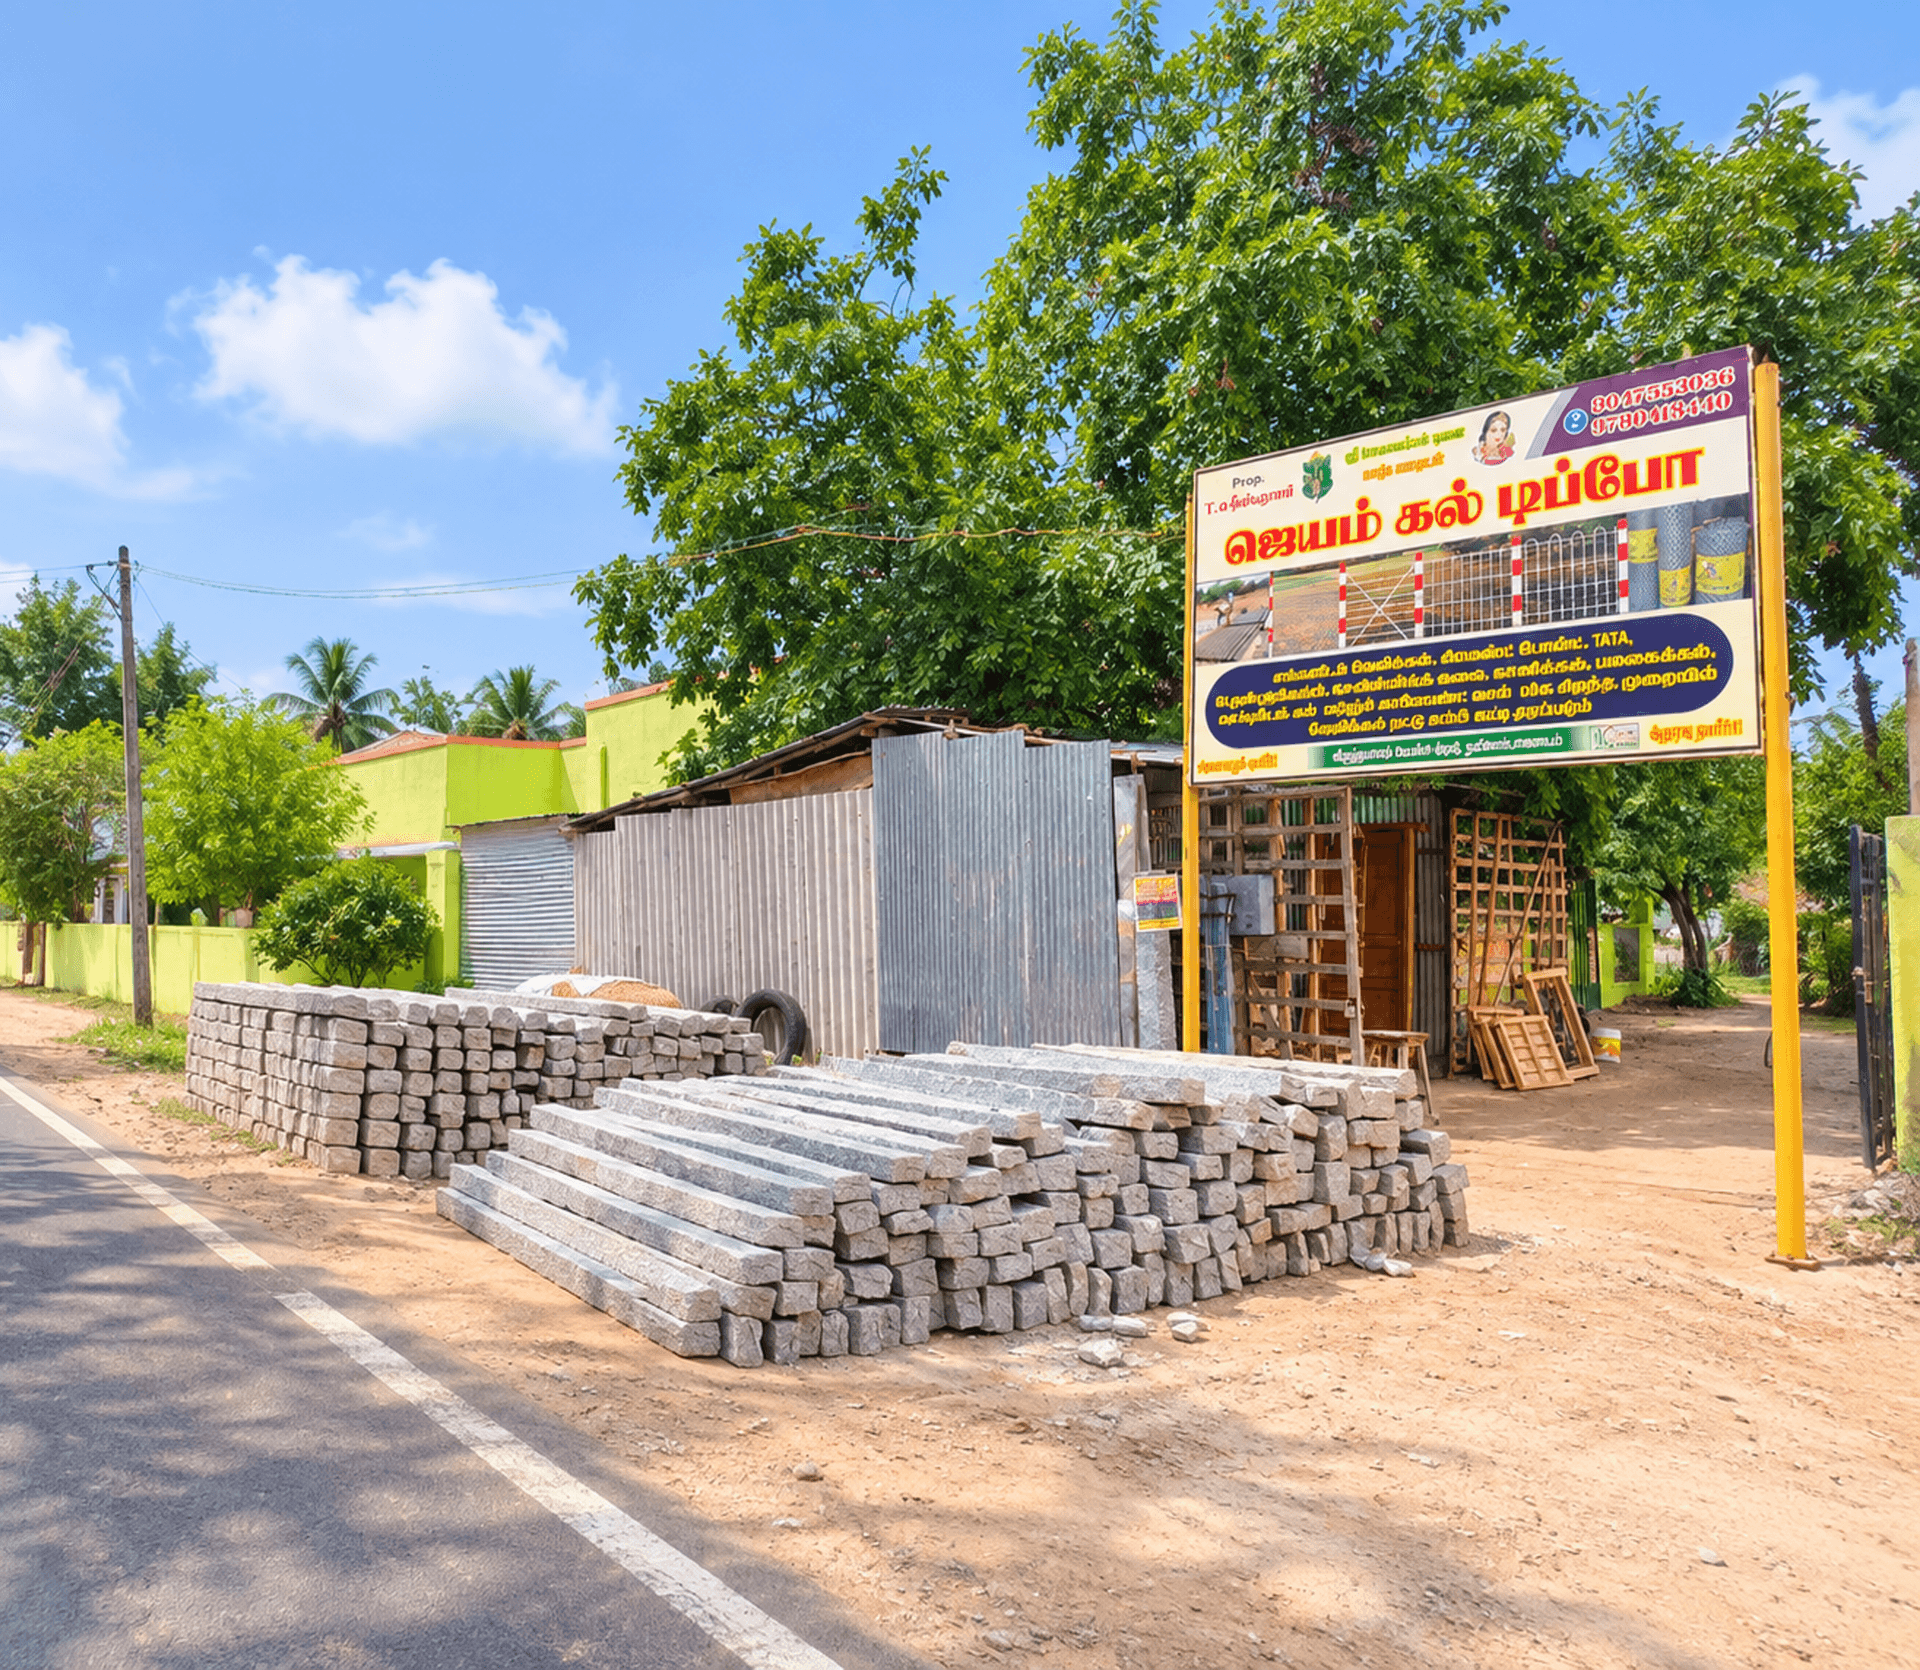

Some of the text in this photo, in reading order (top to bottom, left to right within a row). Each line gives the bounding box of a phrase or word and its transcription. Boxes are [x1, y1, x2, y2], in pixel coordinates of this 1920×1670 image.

[1232, 474, 1265, 489] Prop.
[1225, 496, 1382, 565] ஜெயம்
[1395, 478, 1485, 536] கல்
[1498, 446, 1706, 526] டிப்போ
[1592, 630, 1633, 648] TATA,
